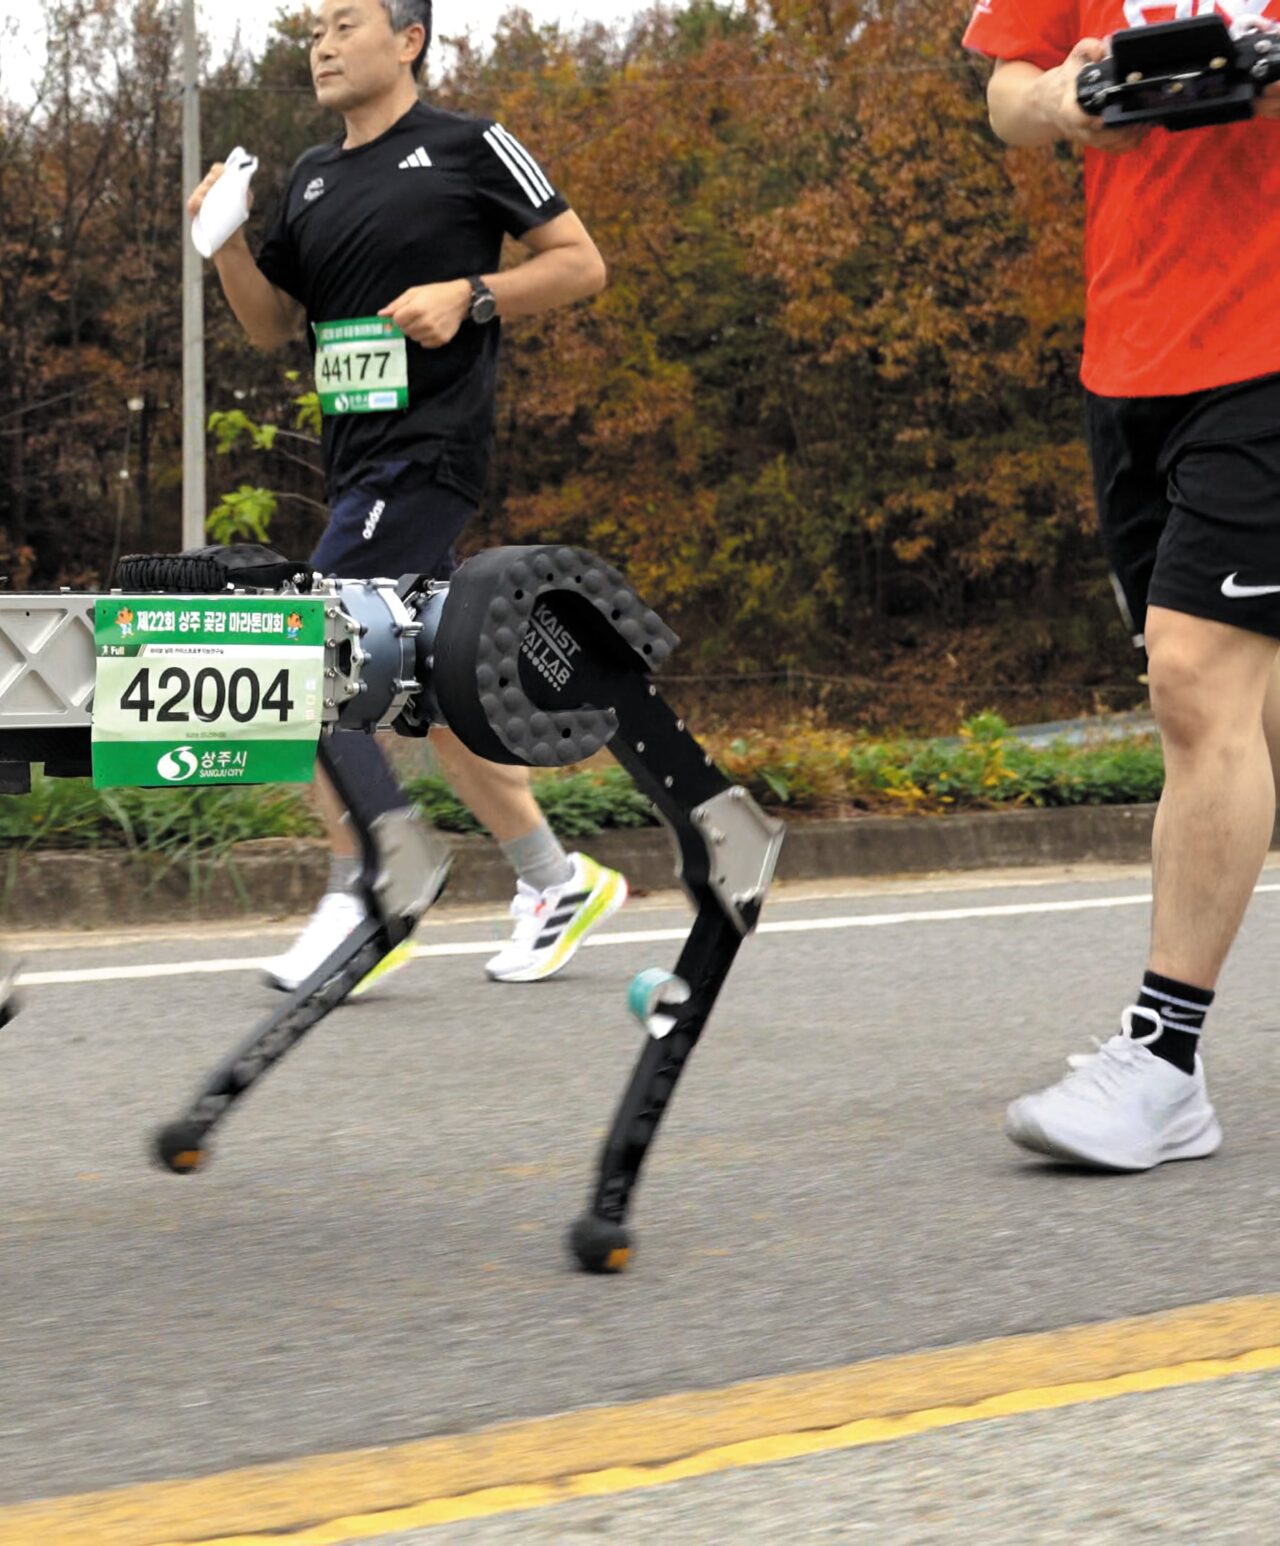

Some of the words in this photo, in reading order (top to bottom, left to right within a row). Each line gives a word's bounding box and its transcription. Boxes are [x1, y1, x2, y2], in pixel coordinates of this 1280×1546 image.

[321, 351, 391, 383] 44177
[362, 500, 386, 539] adidas
[136, 611, 176, 632] 제22회
[179, 611, 201, 632] 상주
[204, 611, 226, 633] 곶감
[229, 612, 284, 633] 마라톤대회
[534, 603, 582, 657] KAIST
[111, 645, 125, 655] Full
[520, 630, 543, 651] AI
[540, 647, 571, 685] LAB
[120, 667, 294, 723] 42004
[200, 769, 226, 778] SANGJU
[227, 768, 245, 777] CITY
[201, 750, 248, 769] 상주시
